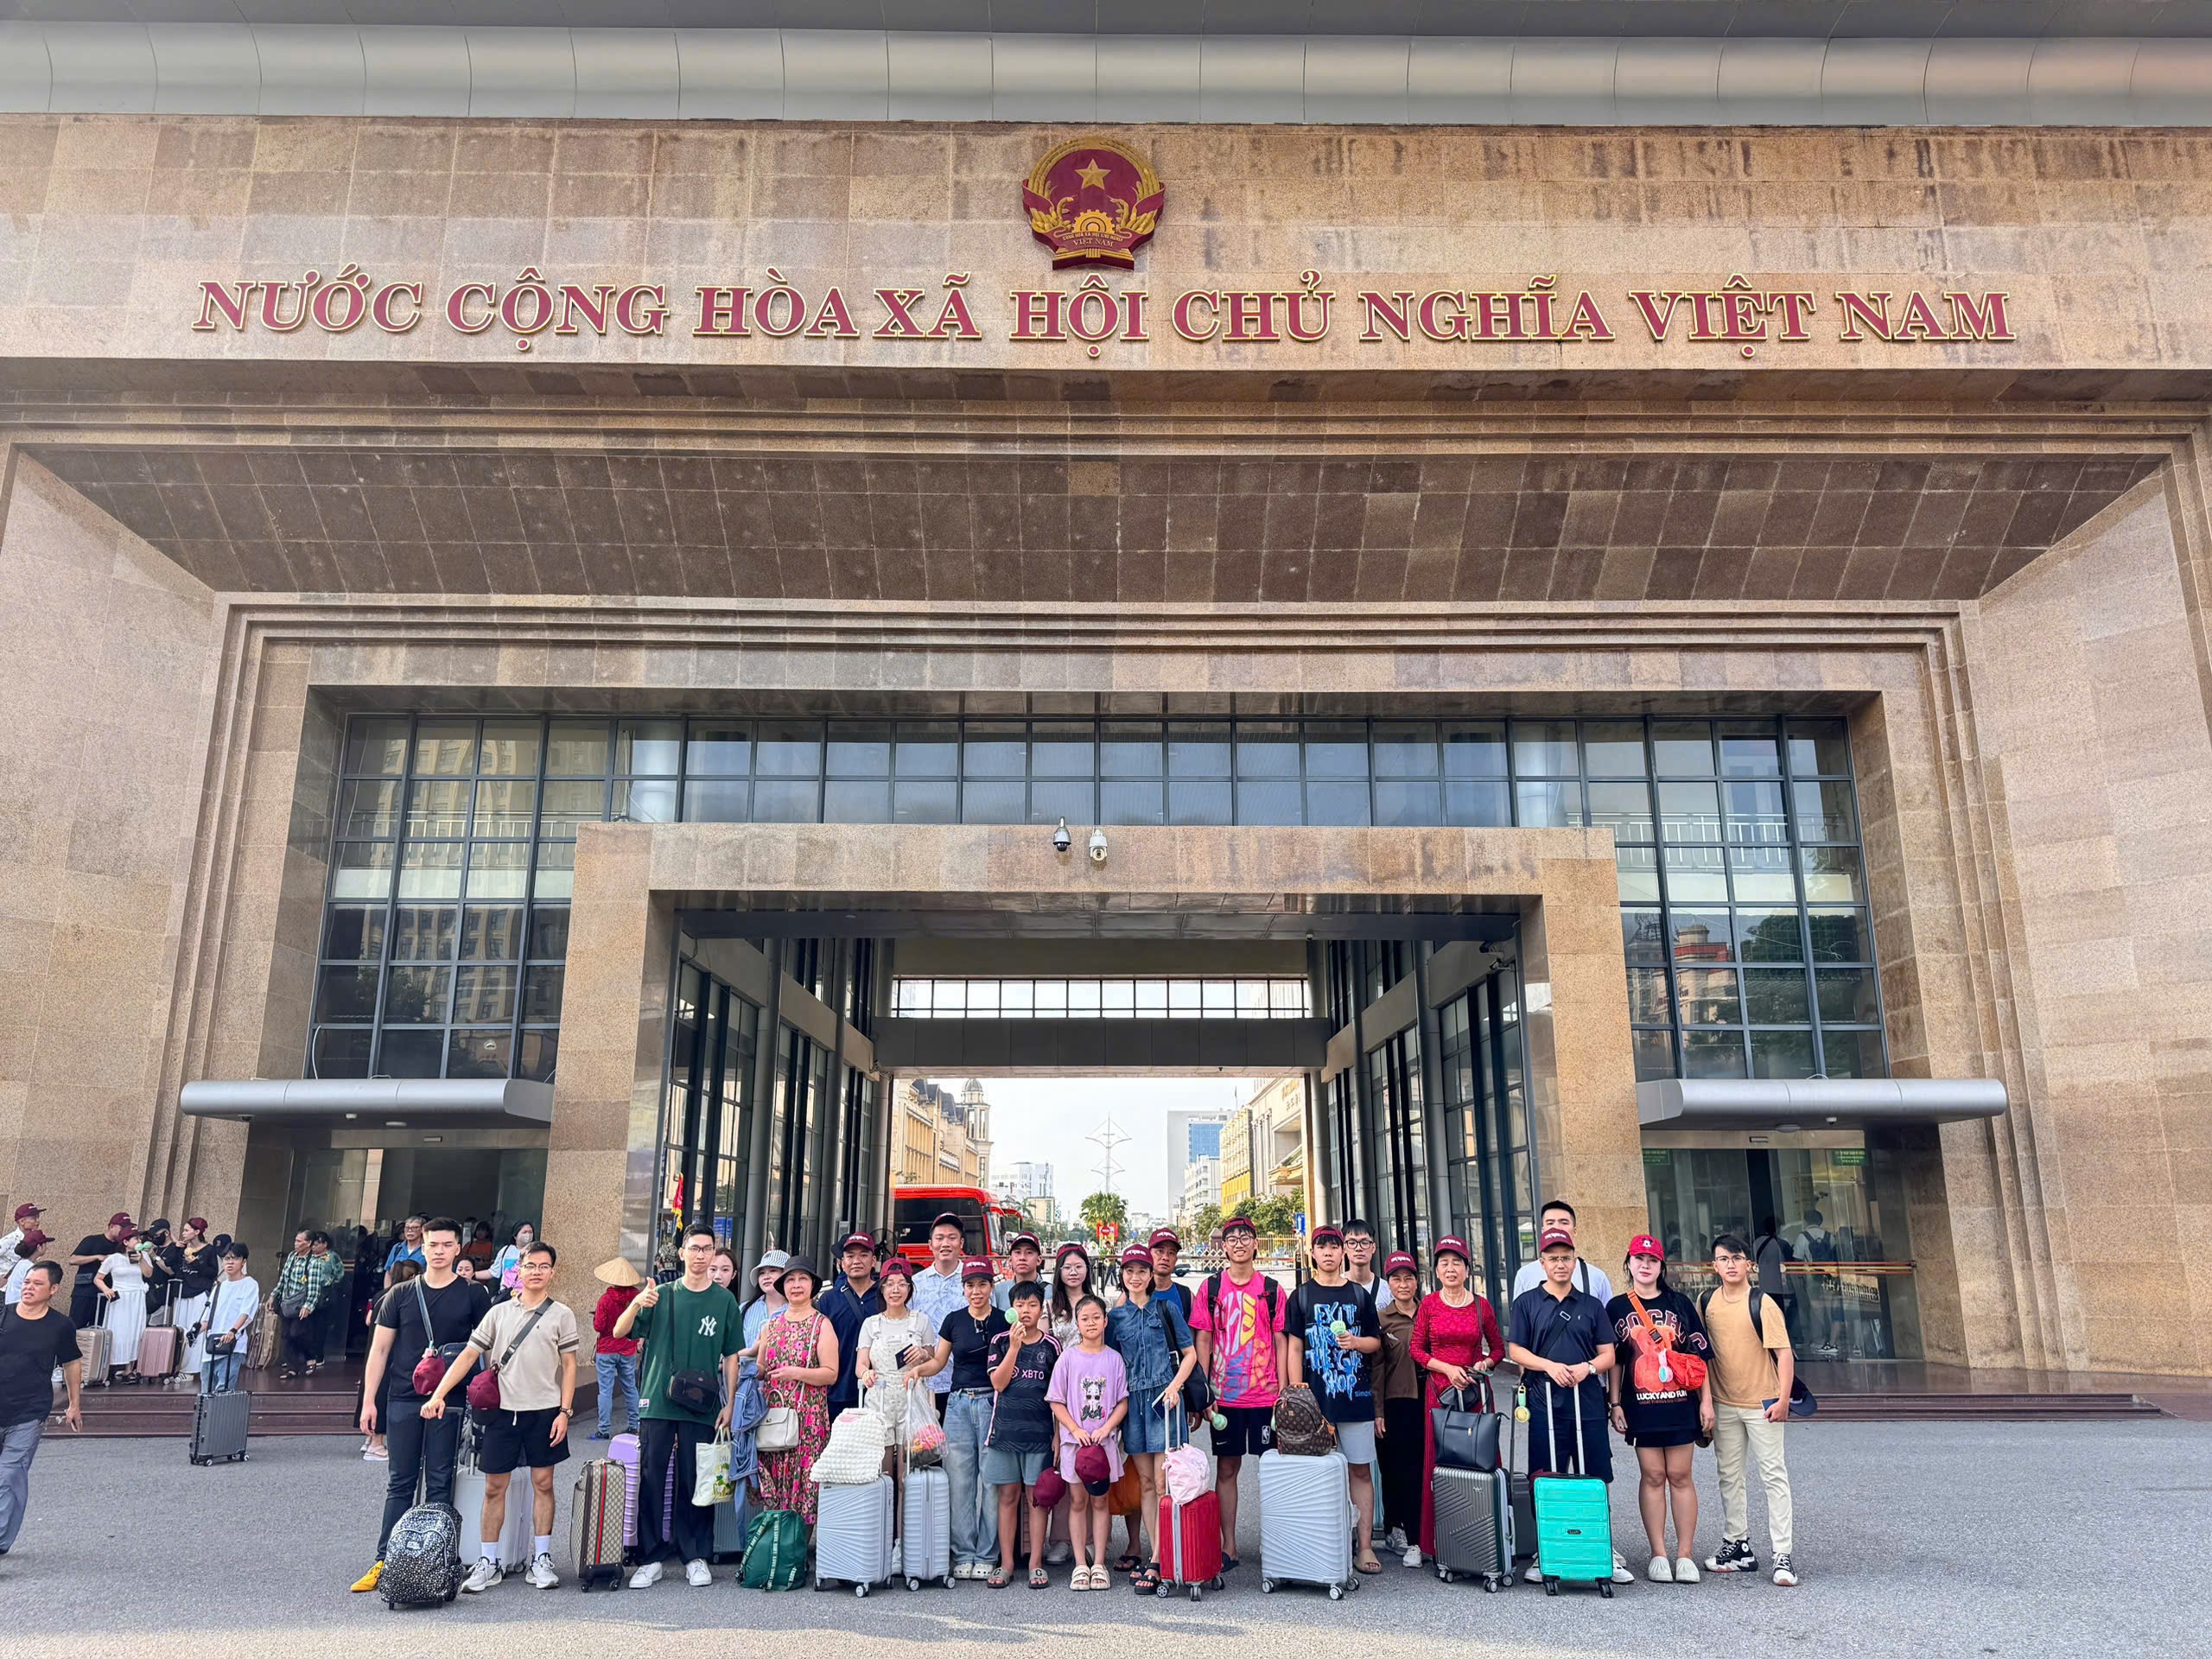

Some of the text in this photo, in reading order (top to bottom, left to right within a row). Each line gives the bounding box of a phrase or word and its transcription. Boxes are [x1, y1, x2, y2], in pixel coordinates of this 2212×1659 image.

[192, 262, 2018, 359] NƯỚC CỘNG HÒA XÃ HỘI CHỦ NGHĨA VIỆT NAM
[697, 1314, 717, 1337] NY
[1021, 1370, 1045, 1380] XBTO
[1637, 1392, 1660, 1401] LUCKY
